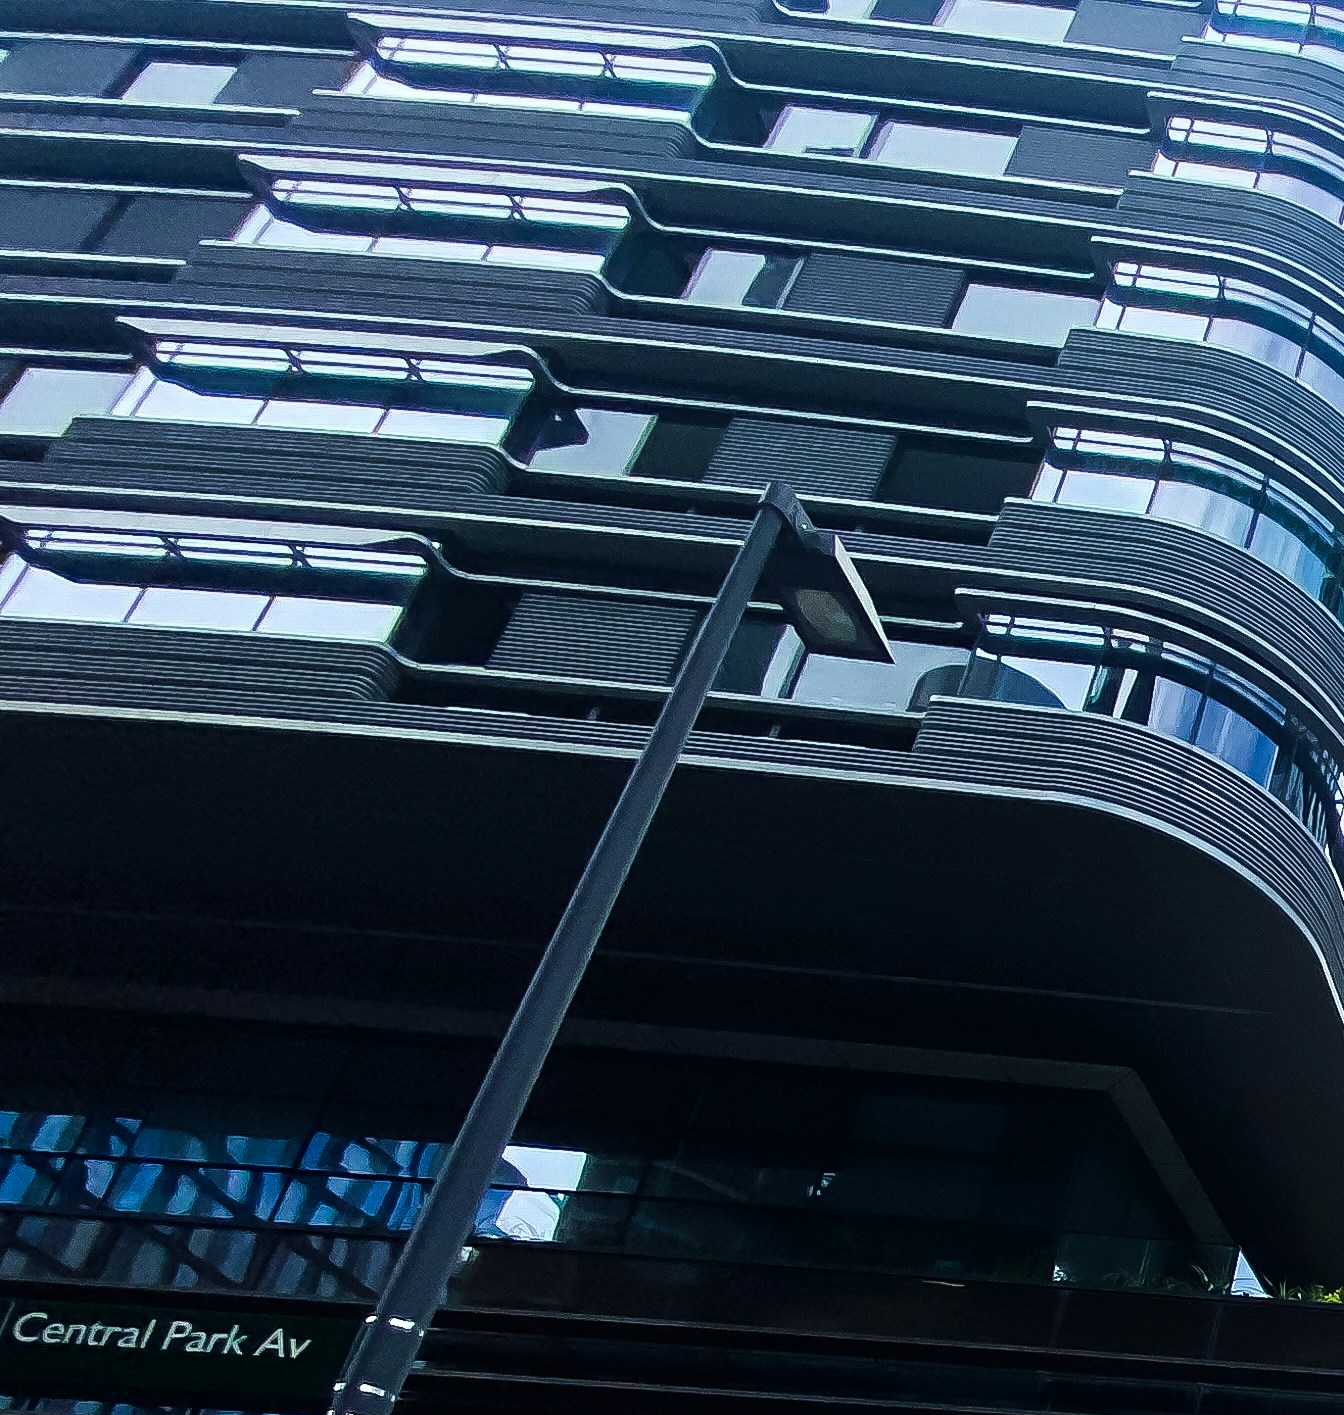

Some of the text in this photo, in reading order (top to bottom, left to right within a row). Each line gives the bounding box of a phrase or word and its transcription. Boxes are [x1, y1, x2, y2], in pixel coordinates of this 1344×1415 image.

[13, 1311, 312, 1359] Central Park Av
